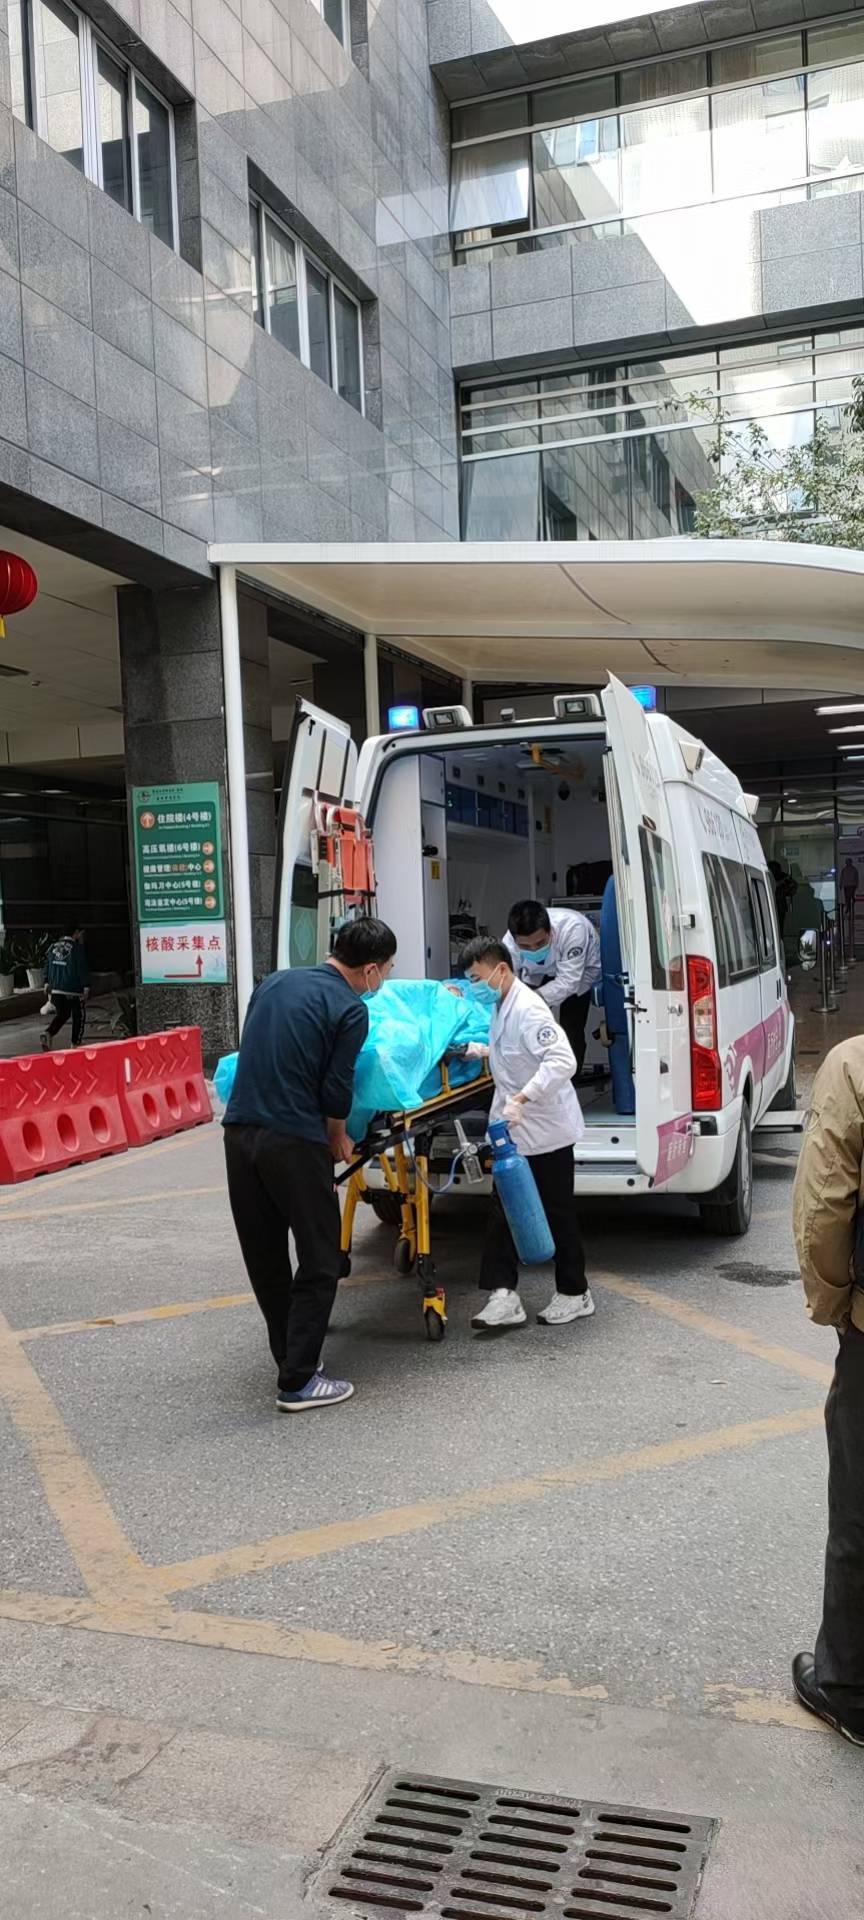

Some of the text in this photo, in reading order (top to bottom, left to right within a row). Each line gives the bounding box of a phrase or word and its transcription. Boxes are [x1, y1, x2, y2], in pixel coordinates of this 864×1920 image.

[157, 811, 212, 824] 住院楼(4号楼)
[145, 935, 221, 952] 核酸采集点
